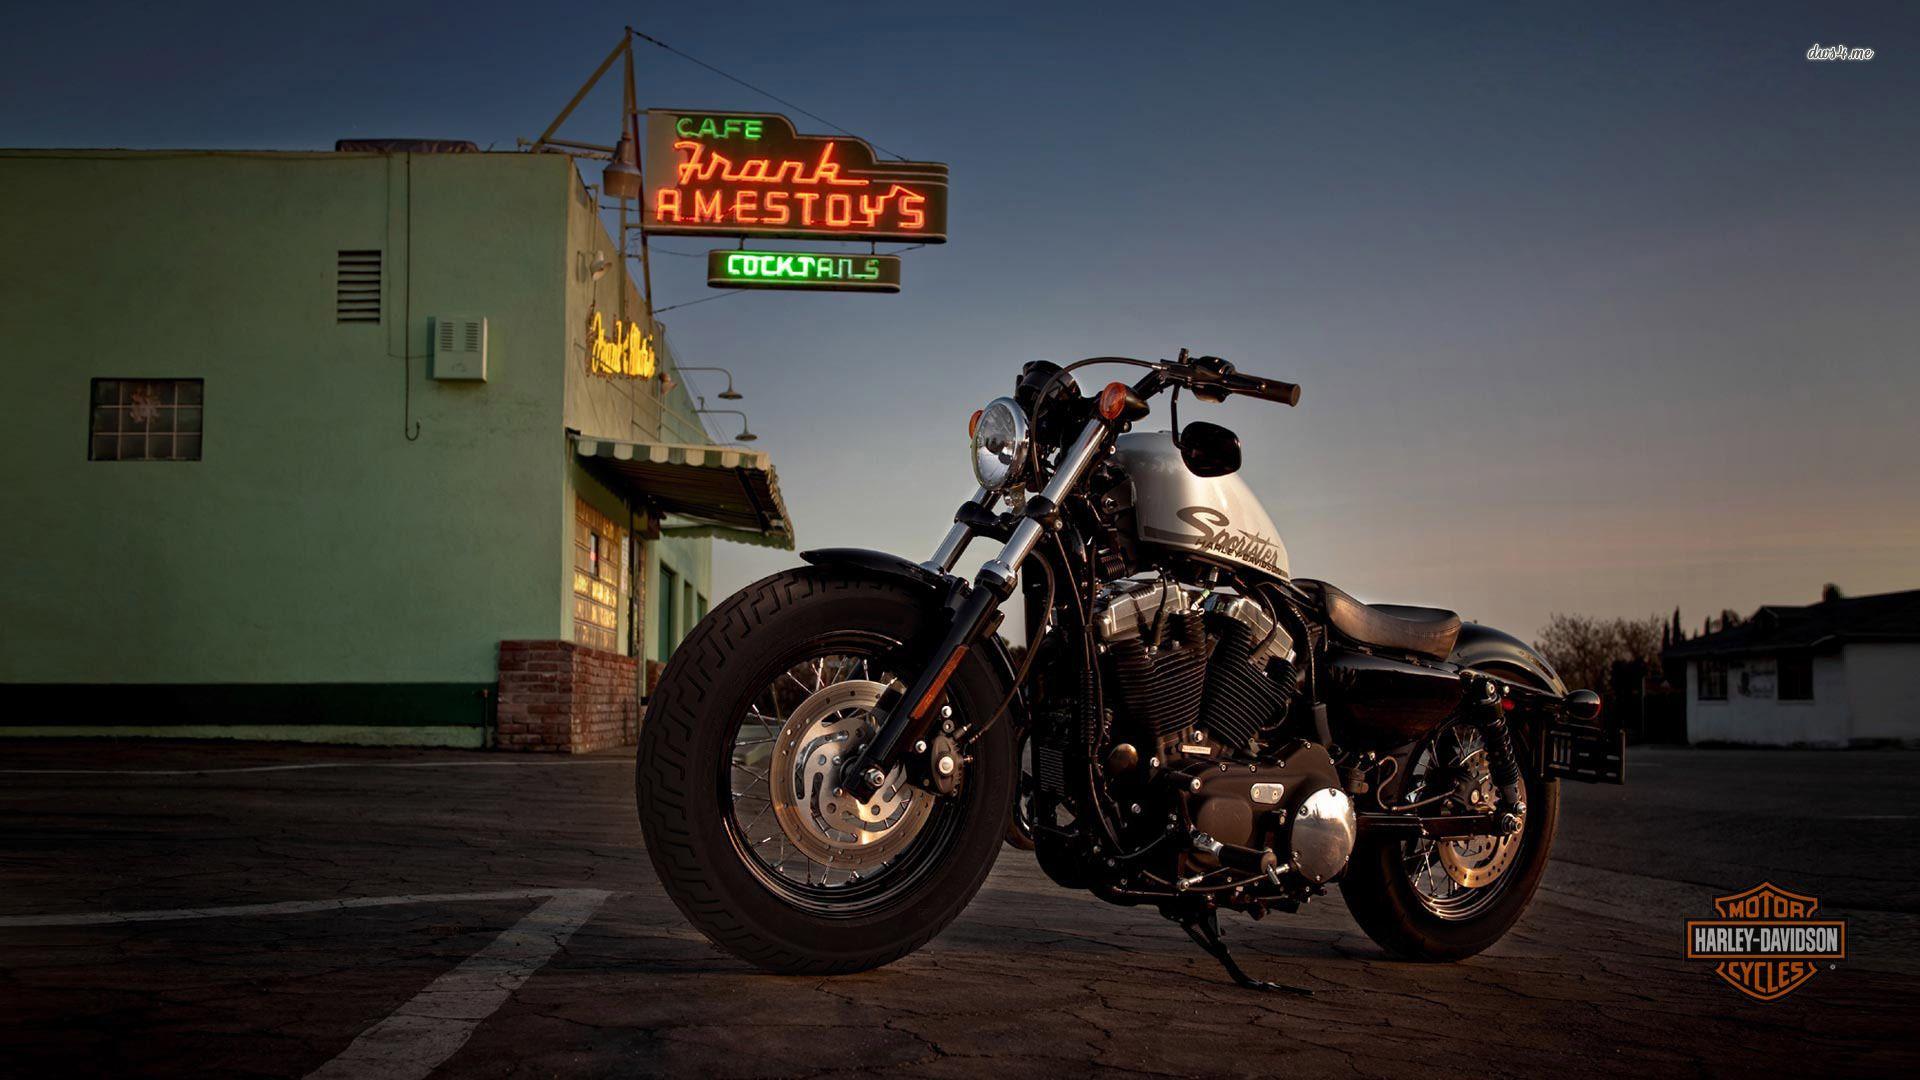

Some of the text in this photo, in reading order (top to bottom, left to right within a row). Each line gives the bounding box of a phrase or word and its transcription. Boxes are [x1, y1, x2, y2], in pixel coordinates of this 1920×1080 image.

[675, 117, 763, 139] CAFE
[673, 141, 869, 185] Frank
[656, 184, 926, 228] AMESTOY'S
[727, 254, 880, 280] COCKTAILS
[1176, 506, 1280, 567] Sportster
[1195, 538, 1283, 576] HARLEY-DAVIDSON
